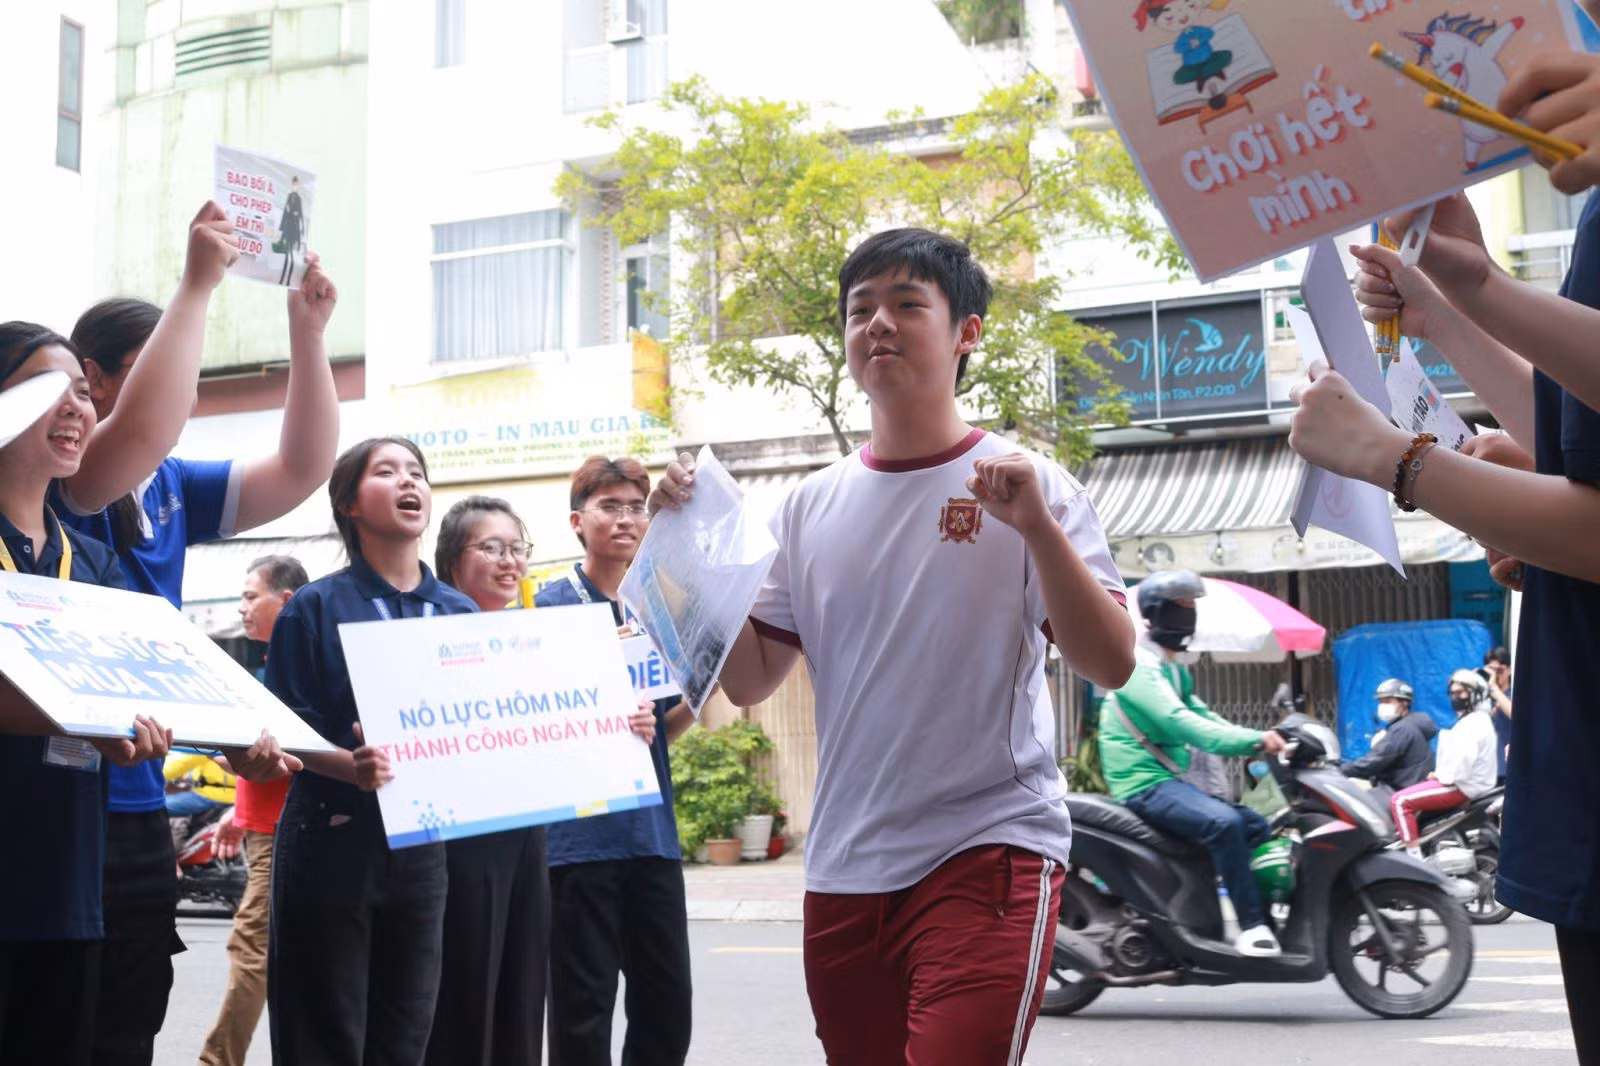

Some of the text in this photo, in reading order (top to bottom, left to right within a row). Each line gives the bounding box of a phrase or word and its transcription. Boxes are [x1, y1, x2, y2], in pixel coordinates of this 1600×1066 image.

[1277, 63, 1373, 156] hết
[230, 193, 249, 209] CHO
[1248, 170, 1356, 235] mình
[235, 215, 265, 234] EM THI
[1120, 330, 1267, 389] Wendy
[496, 424, 520, 441] IN
[440, 699, 491, 728] LỰC
[496, 689, 551, 718] HÔM
[554, 687, 599, 711] NAY
[379, 735, 461, 763] THÀNH
[465, 726, 528, 753] CÔNG
[532, 717, 589, 744] NGÀY
